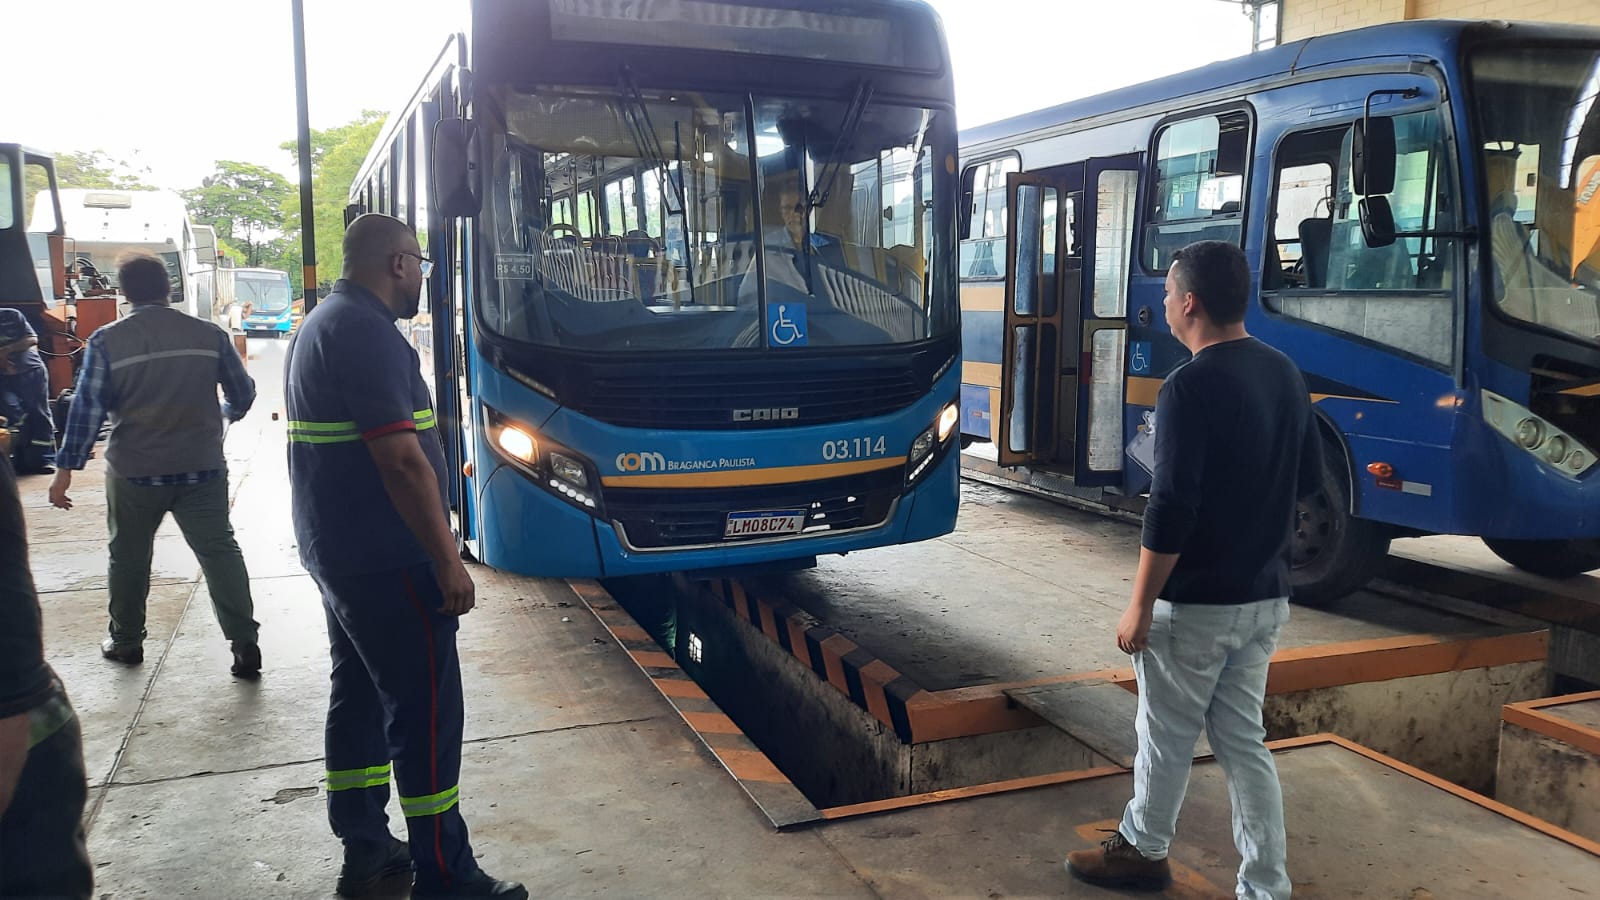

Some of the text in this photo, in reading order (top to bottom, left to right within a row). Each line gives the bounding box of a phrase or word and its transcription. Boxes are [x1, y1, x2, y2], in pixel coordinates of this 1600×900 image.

[497, 264, 509, 274] R$
[732, 407, 799, 422] CAIO
[822, 435, 886, 461] 03.114
